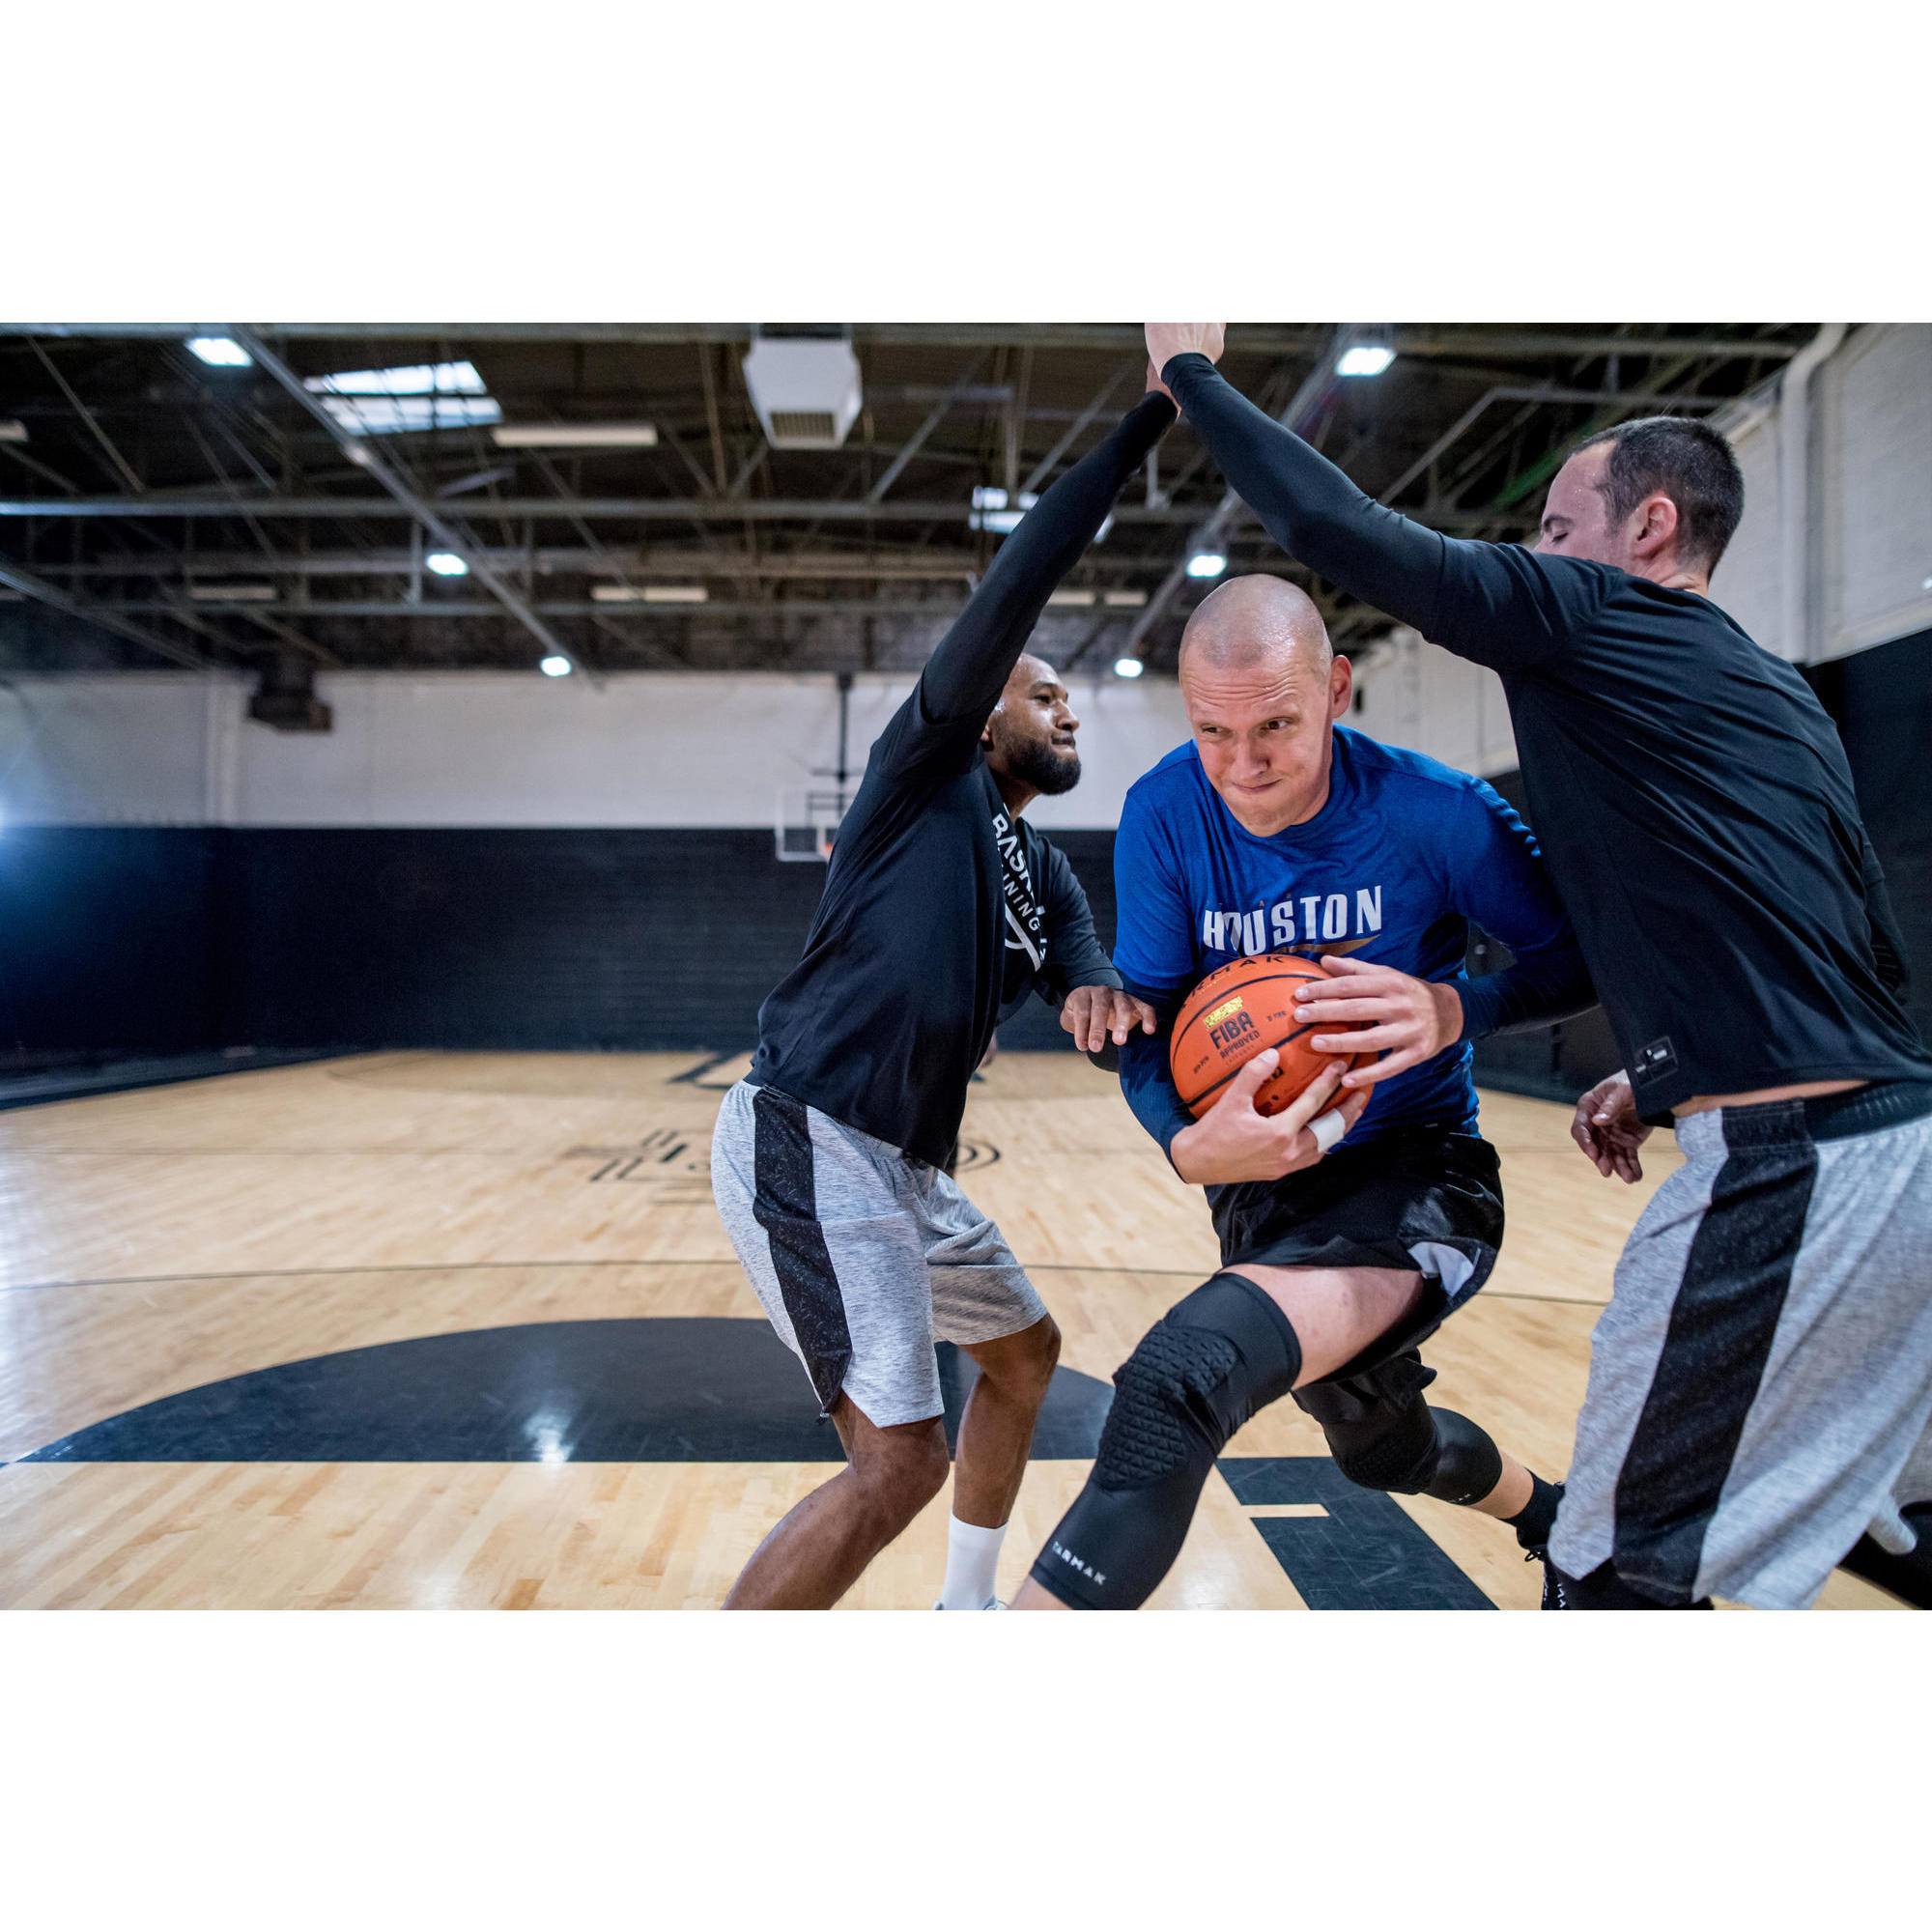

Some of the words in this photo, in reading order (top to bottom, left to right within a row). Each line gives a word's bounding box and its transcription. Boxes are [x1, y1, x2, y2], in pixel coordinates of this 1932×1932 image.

[1203, 885, 1382, 956] HOUSTON
[1209, 1011, 1255, 1050] FIBA
[1220, 1030, 1261, 1059] APPROVED
